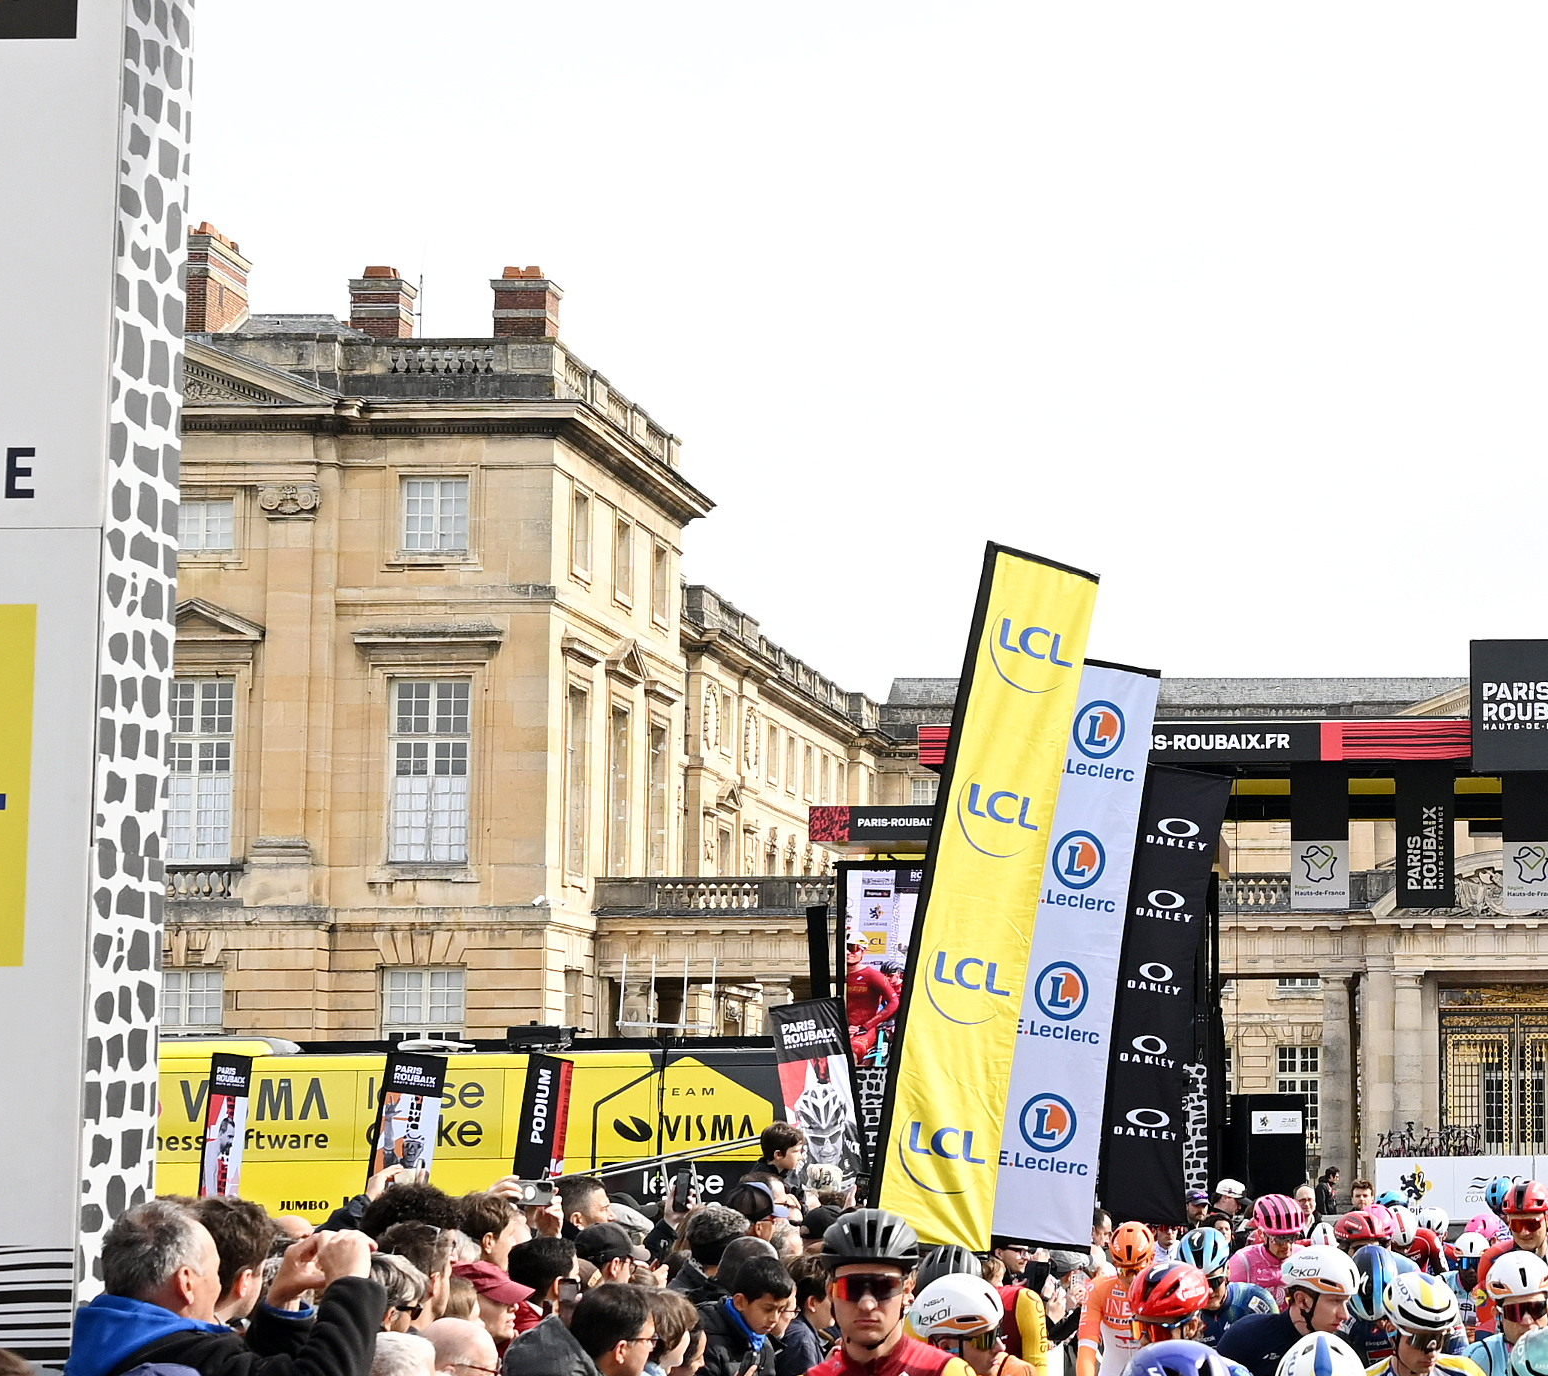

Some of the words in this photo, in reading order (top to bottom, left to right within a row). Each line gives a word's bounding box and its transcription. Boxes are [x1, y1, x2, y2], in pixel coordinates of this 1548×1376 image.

[998, 617, 1073, 668] LCL
[967, 783, 1039, 832] LCL
[1146, 834, 1208, 852] OAKLEY
[1422, 806, 1437, 891] ROUBAIX
[1407, 836, 1423, 891] PARIS
[1135, 905, 1193, 924] OAKLEY
[934, 950, 1011, 997] LCL
[1127, 978, 1183, 997] OAKLEY
[781, 1018, 817, 1035] PARIS
[782, 1027, 838, 1047] ROUBAIX
[395, 1064, 423, 1075] PARIS
[1119, 1051, 1176, 1070] OAKLEY
[215, 1075, 246, 1085] ROUBAIX
[216, 1066, 237, 1076] PARIS
[393, 1073, 437, 1085] ROUBAIX
[530, 1068, 552, 1145] PODIUM
[664, 1114, 755, 1142] VISMA
[1113, 1123, 1178, 1143] OAKLEY
[908, 1119, 987, 1165] LCL
[998, 1149, 1088, 1177] E.Leclerc
[278, 1200, 329, 1210] JUMBO
